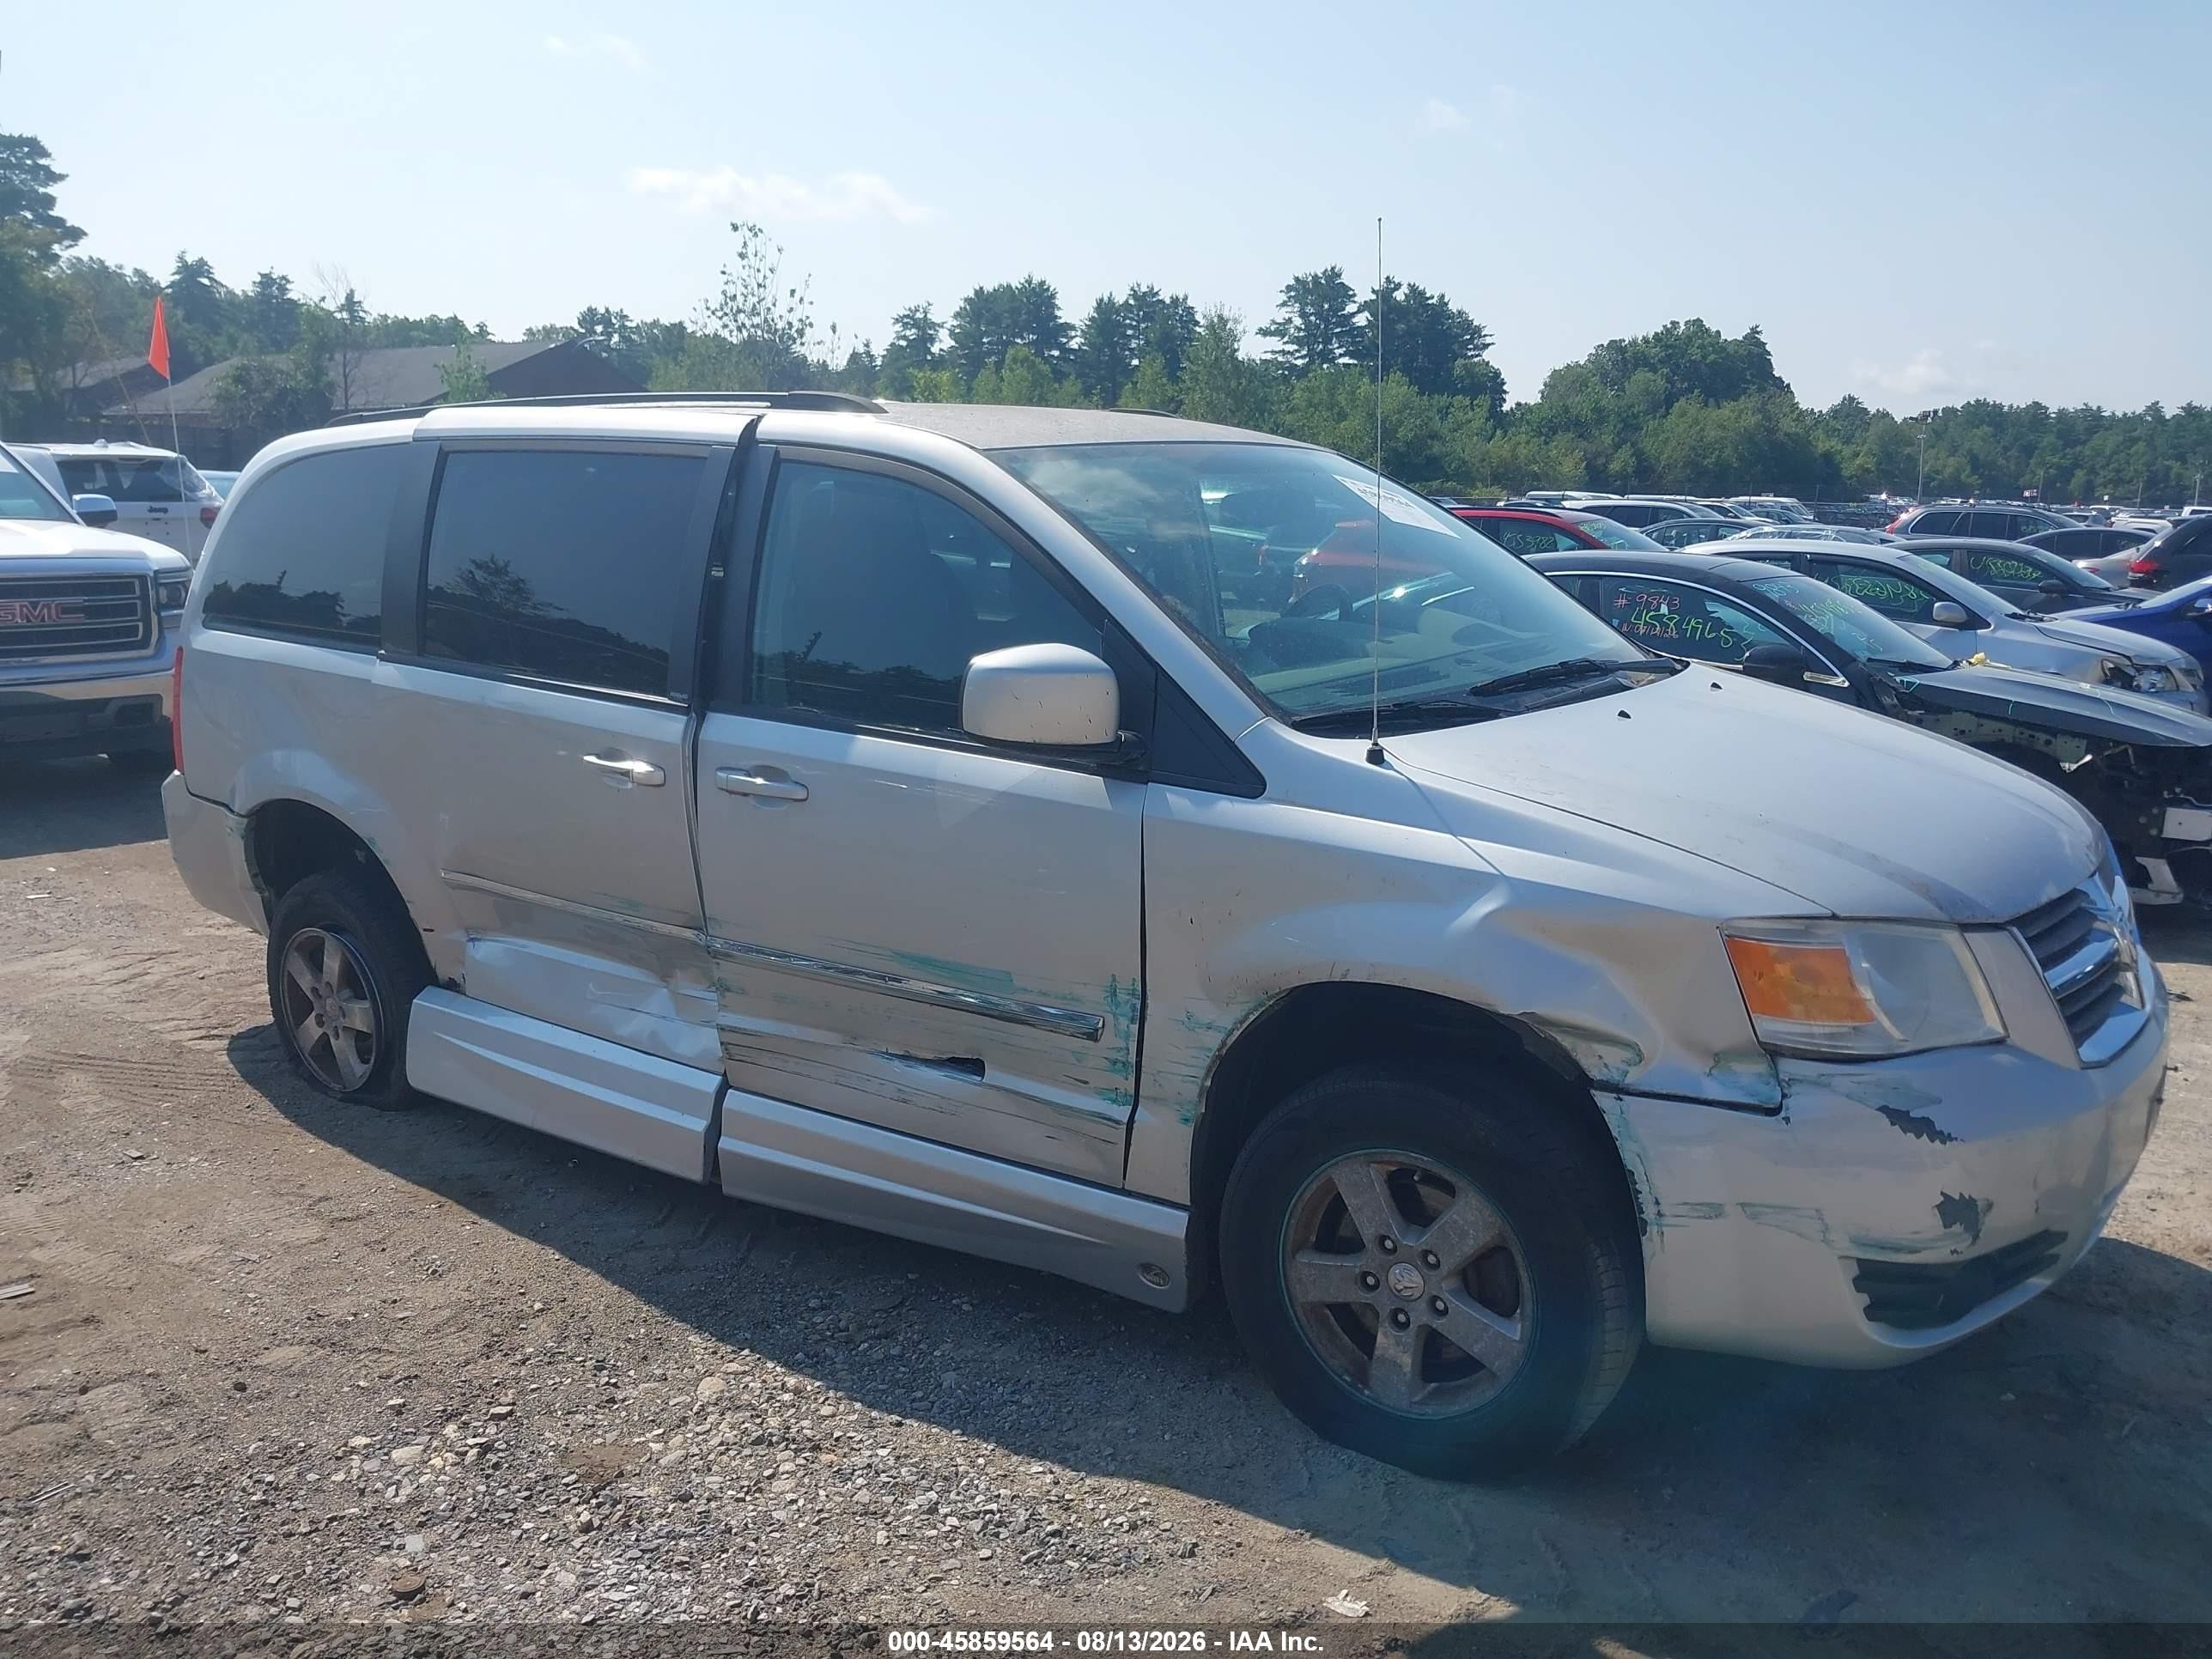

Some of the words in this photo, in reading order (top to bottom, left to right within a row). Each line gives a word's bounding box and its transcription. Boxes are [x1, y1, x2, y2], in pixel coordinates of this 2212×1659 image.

[147, 505, 168, 515] Jeep
[1613, 593, 1631, 609] #
[1636, 593, 1680, 611] 9843
[1631, 607, 1739, 648] 4584965
